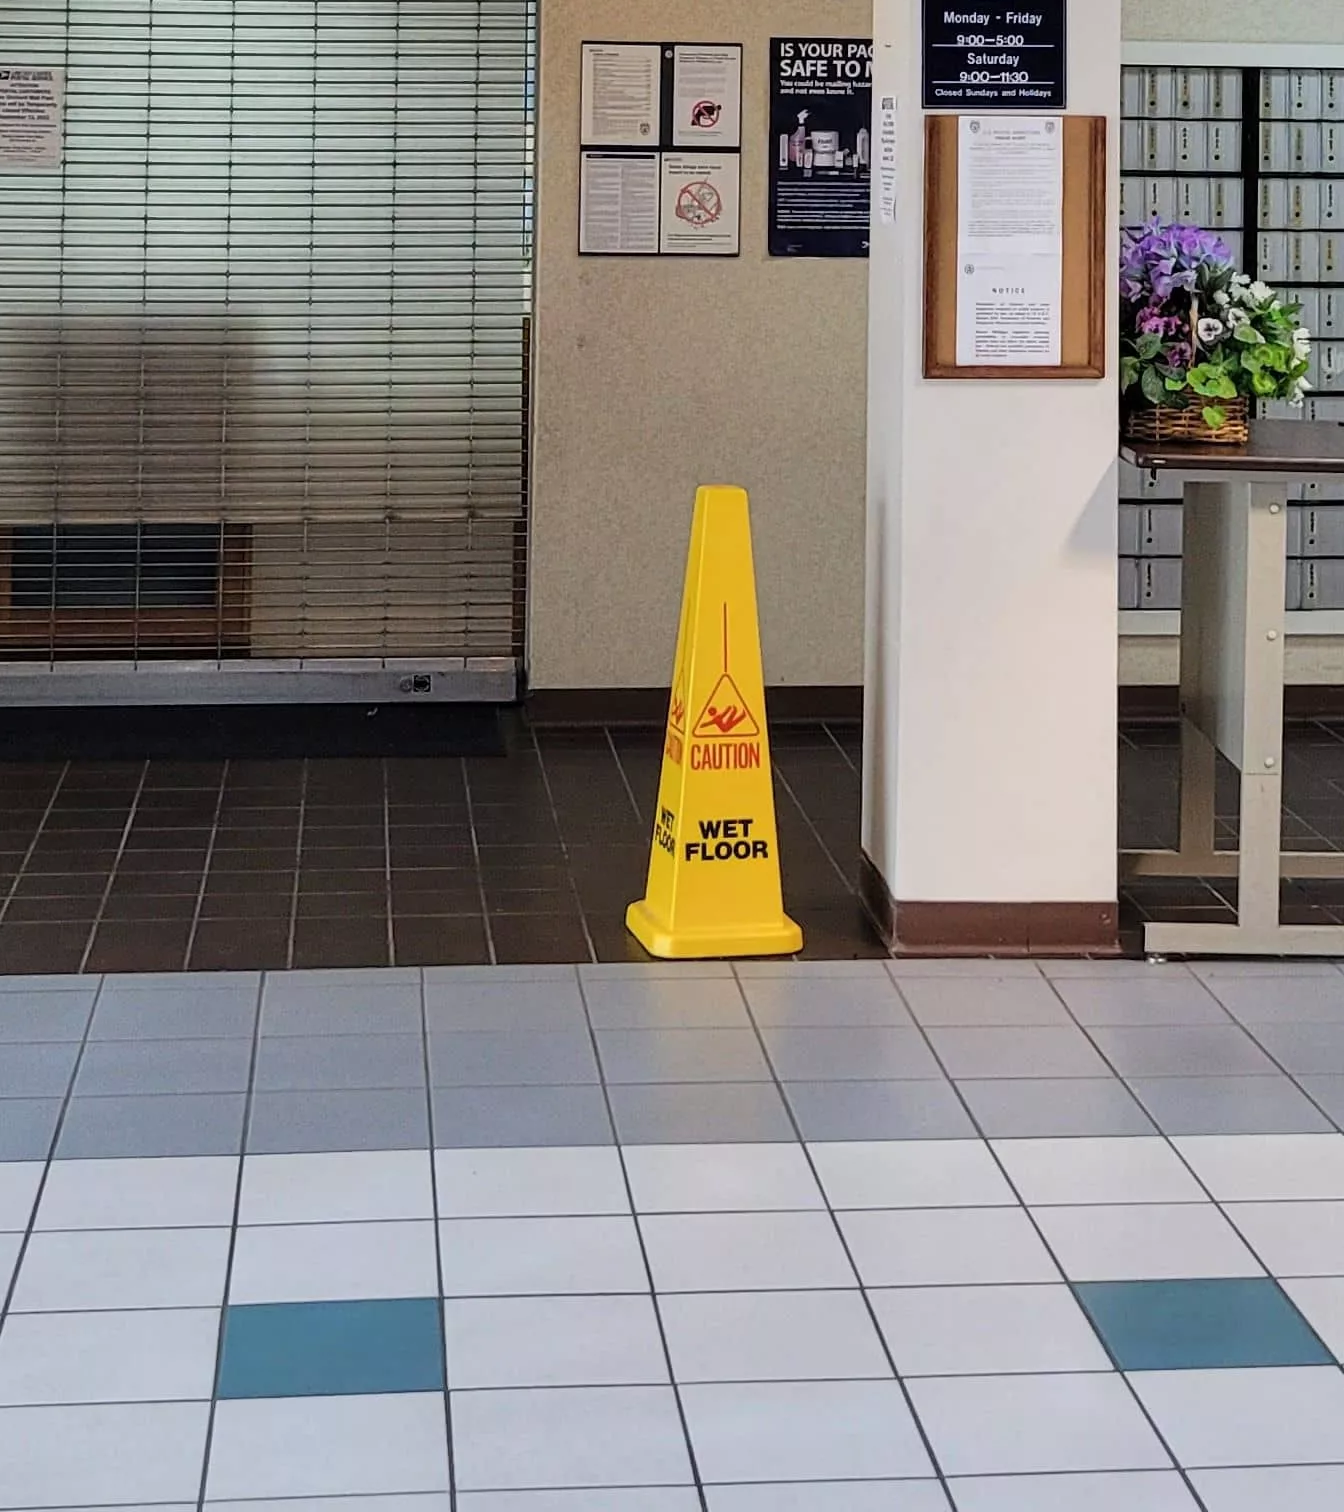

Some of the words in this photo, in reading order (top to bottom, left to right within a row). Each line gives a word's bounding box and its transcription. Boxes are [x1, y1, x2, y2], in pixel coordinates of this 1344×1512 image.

[943, 11, 990, 25] Monday
[1006, 12, 1043, 26] Friday
[780, 42, 794, 57] IS
[798, 43, 843, 58] YOUR
[780, 59, 828, 77] SAFE
[832, 60, 861, 78] TO
[967, 53, 1020, 67] Saturday
[690, 742, 761, 771] CAUTION
[698, 818, 754, 840] WET
[684, 840, 769, 862] FLOOR
